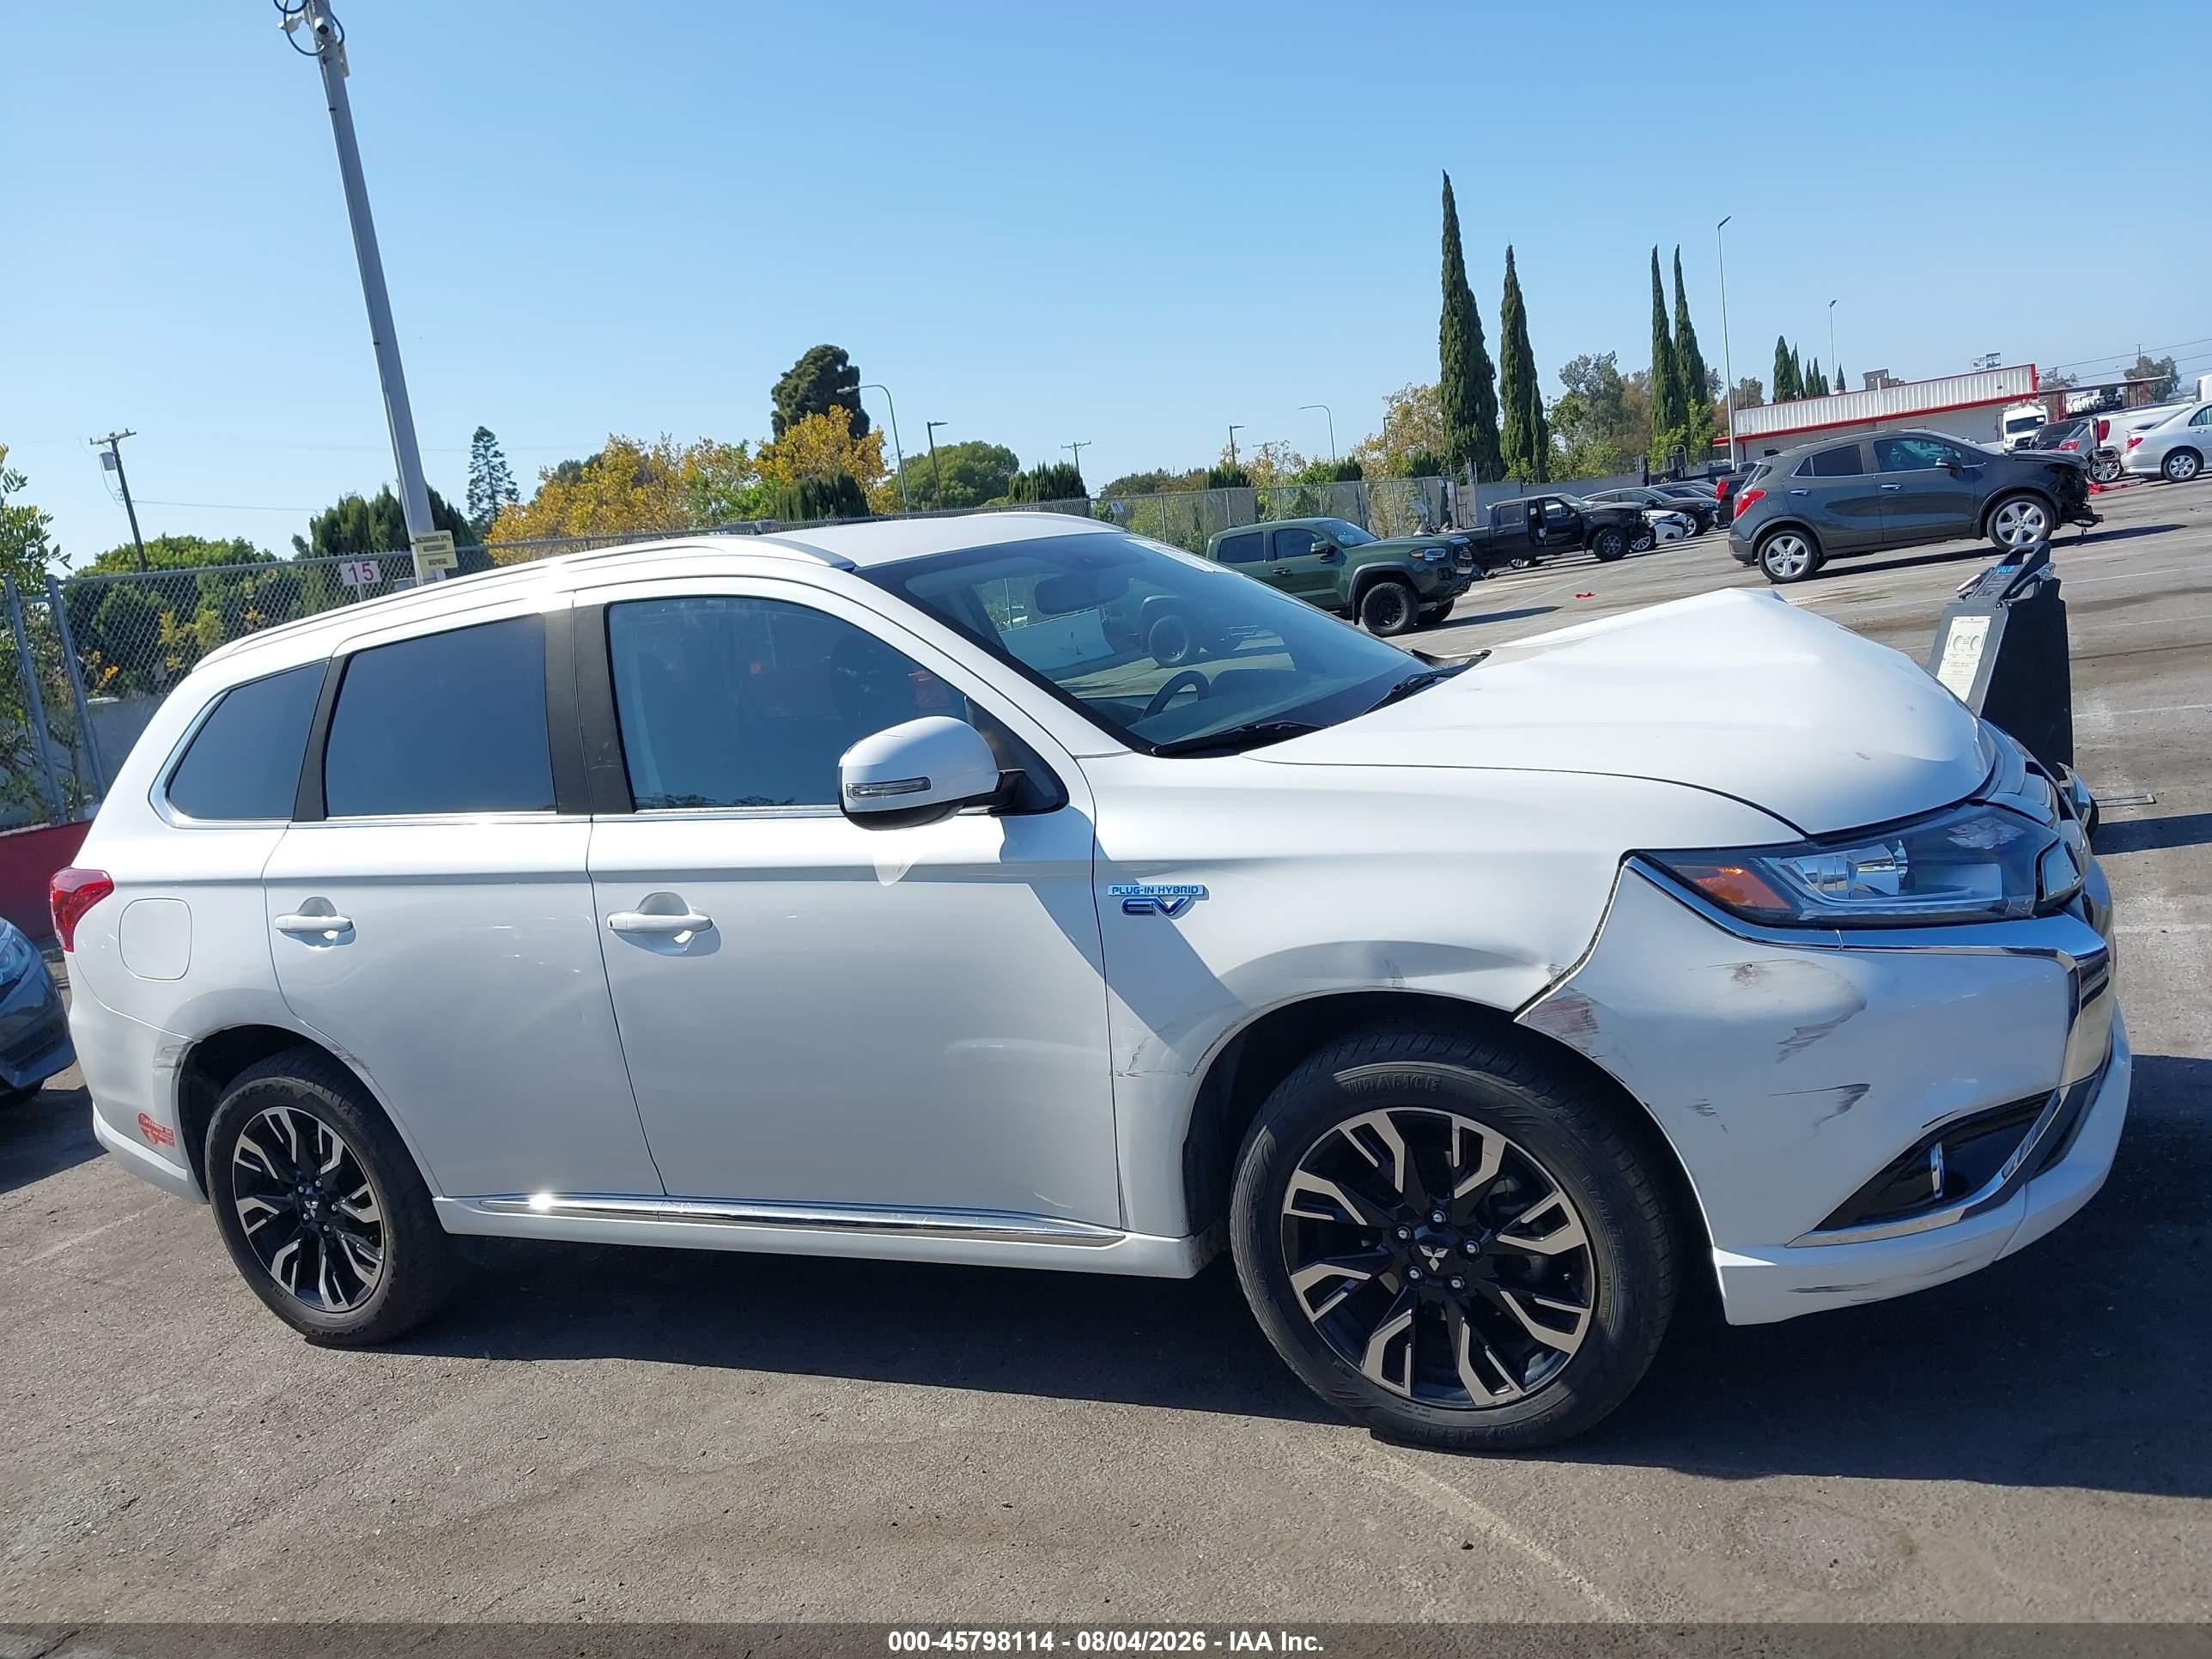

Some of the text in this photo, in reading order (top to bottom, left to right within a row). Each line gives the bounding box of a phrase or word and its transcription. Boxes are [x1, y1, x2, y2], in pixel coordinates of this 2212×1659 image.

[348, 562, 374, 583] 15
[1111, 885, 1200, 895] PLUG-IN HYBRID
[1121, 896, 1190, 916] EV
